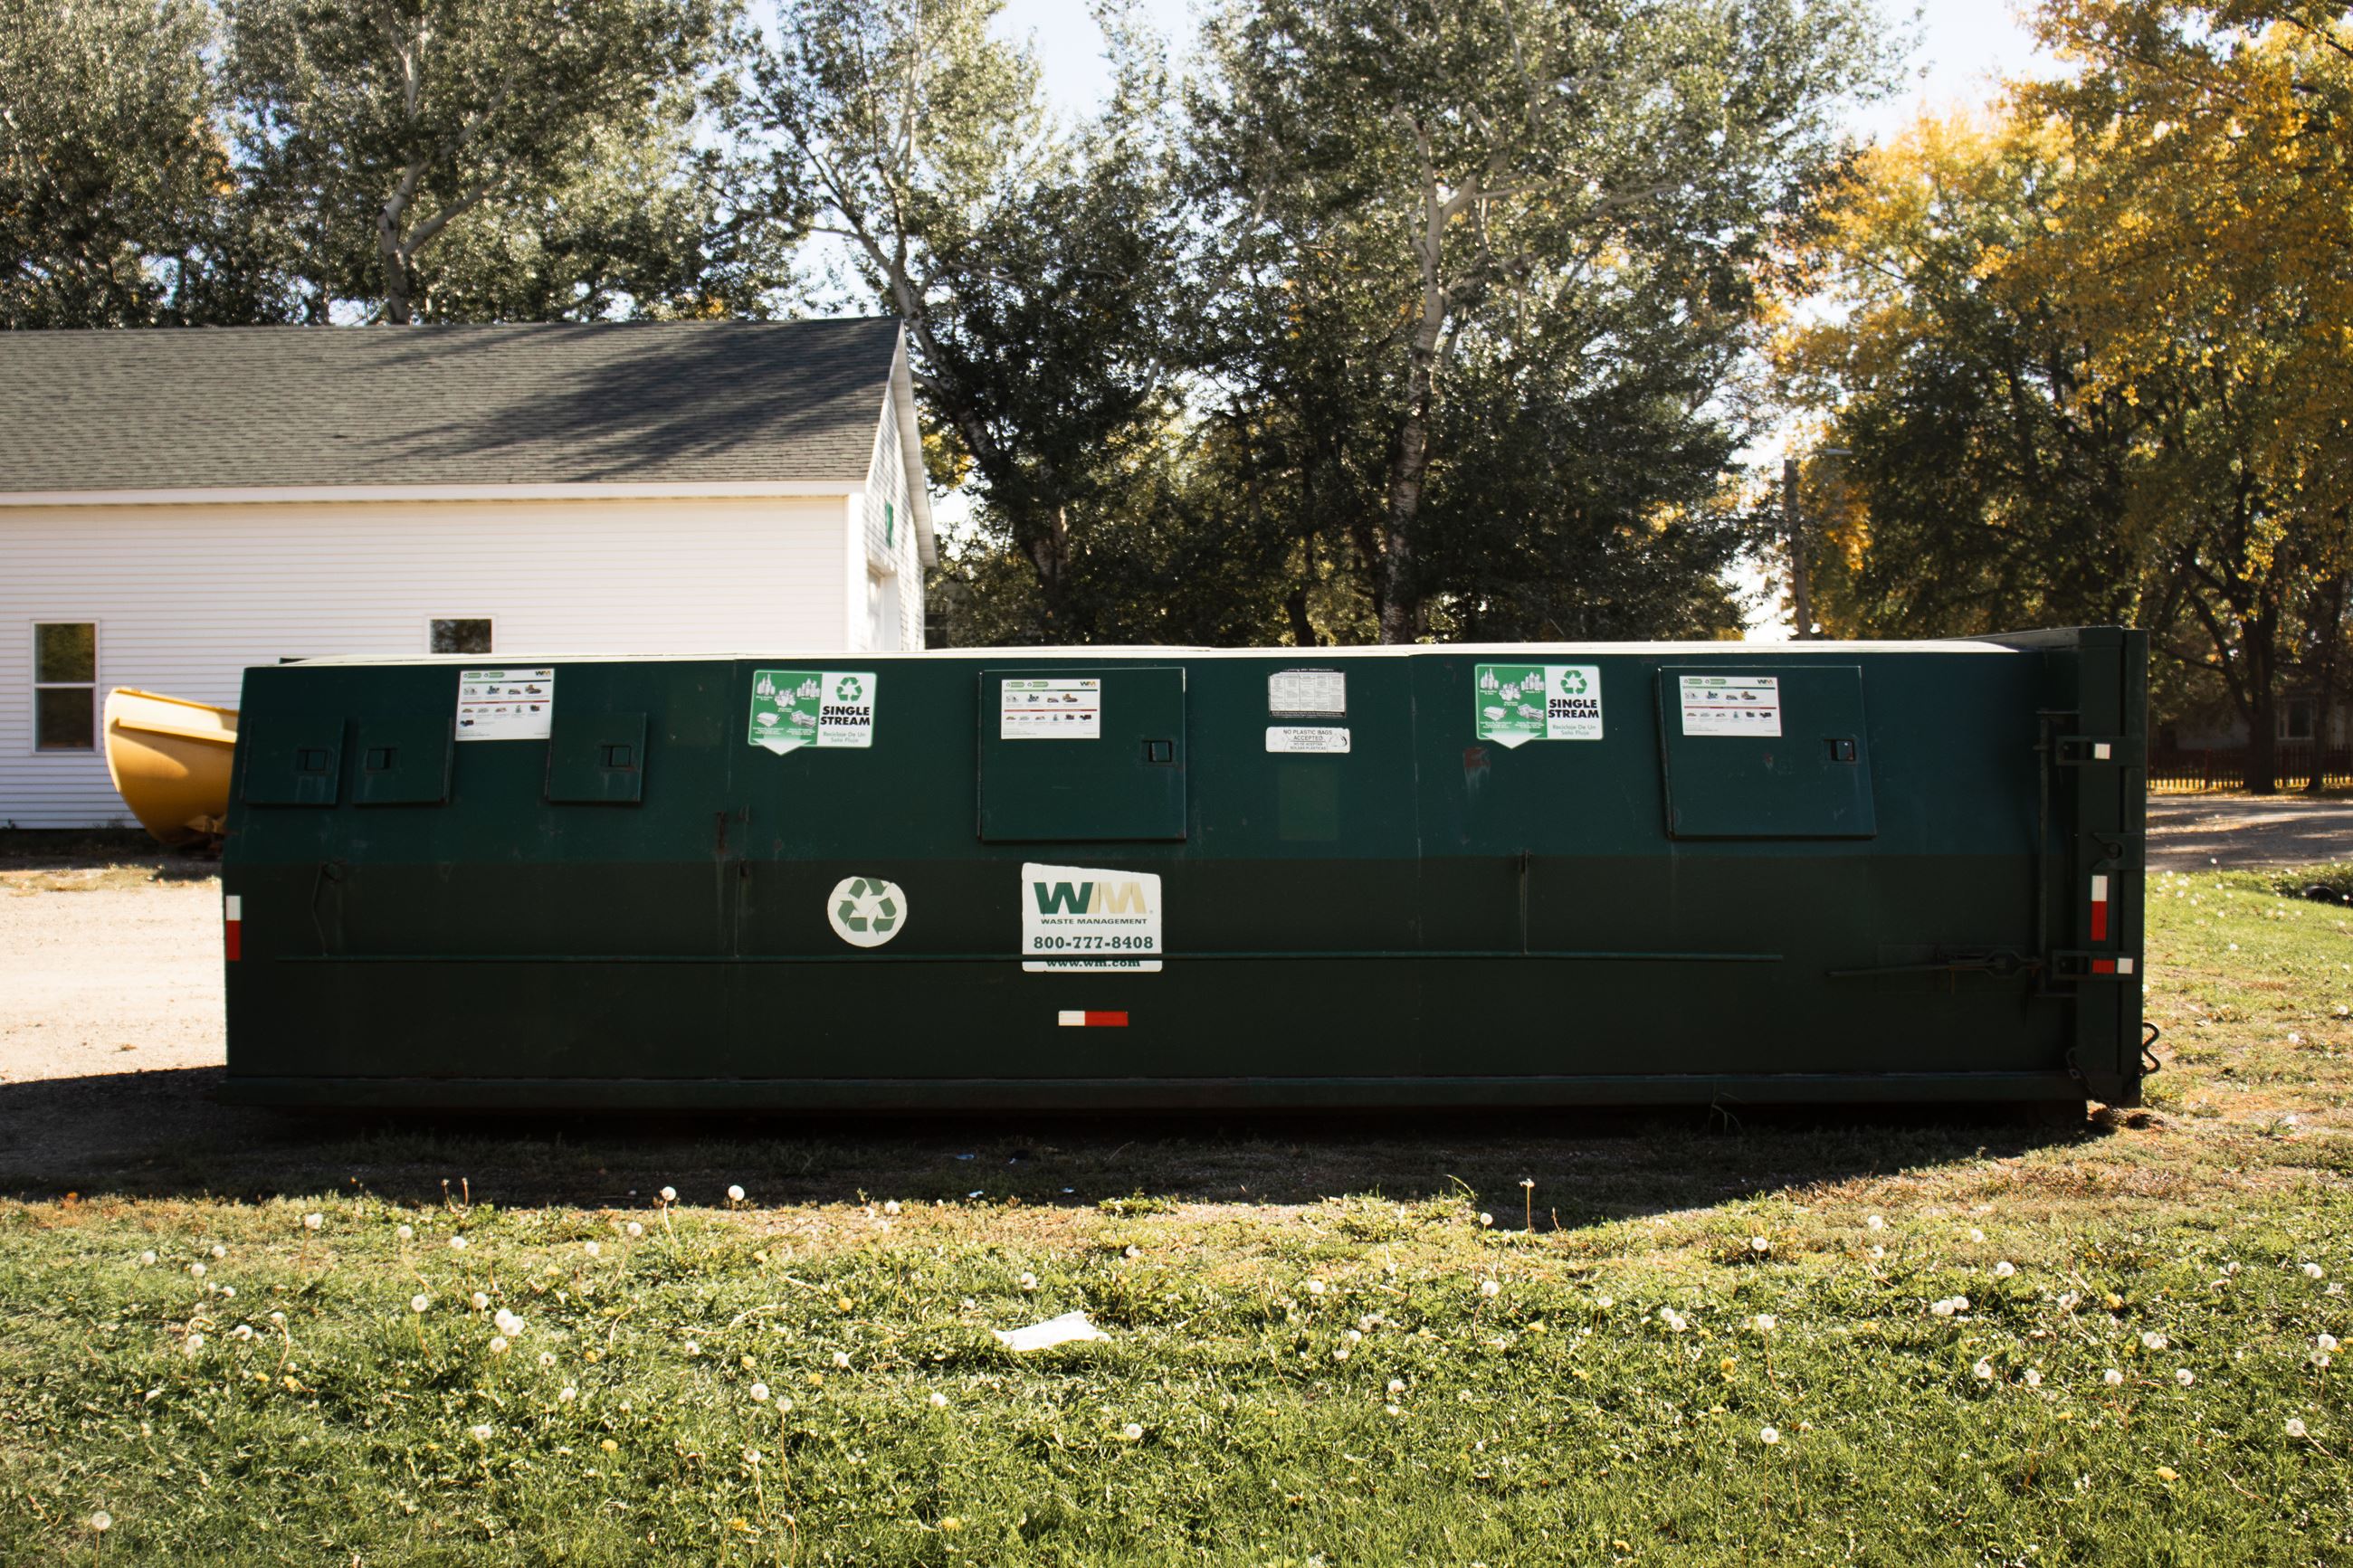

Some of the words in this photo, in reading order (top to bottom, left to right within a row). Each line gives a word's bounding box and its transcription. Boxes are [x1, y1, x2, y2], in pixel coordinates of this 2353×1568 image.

[1548, 698, 1597, 708] SINGLE
[822, 706, 871, 716] SINGLE
[1548, 708, 1599, 718] STREAM
[820, 716, 871, 726] STREAM
[1033, 881, 1148, 915] WM
[1034, 936, 1154, 949] 800-777-8408
